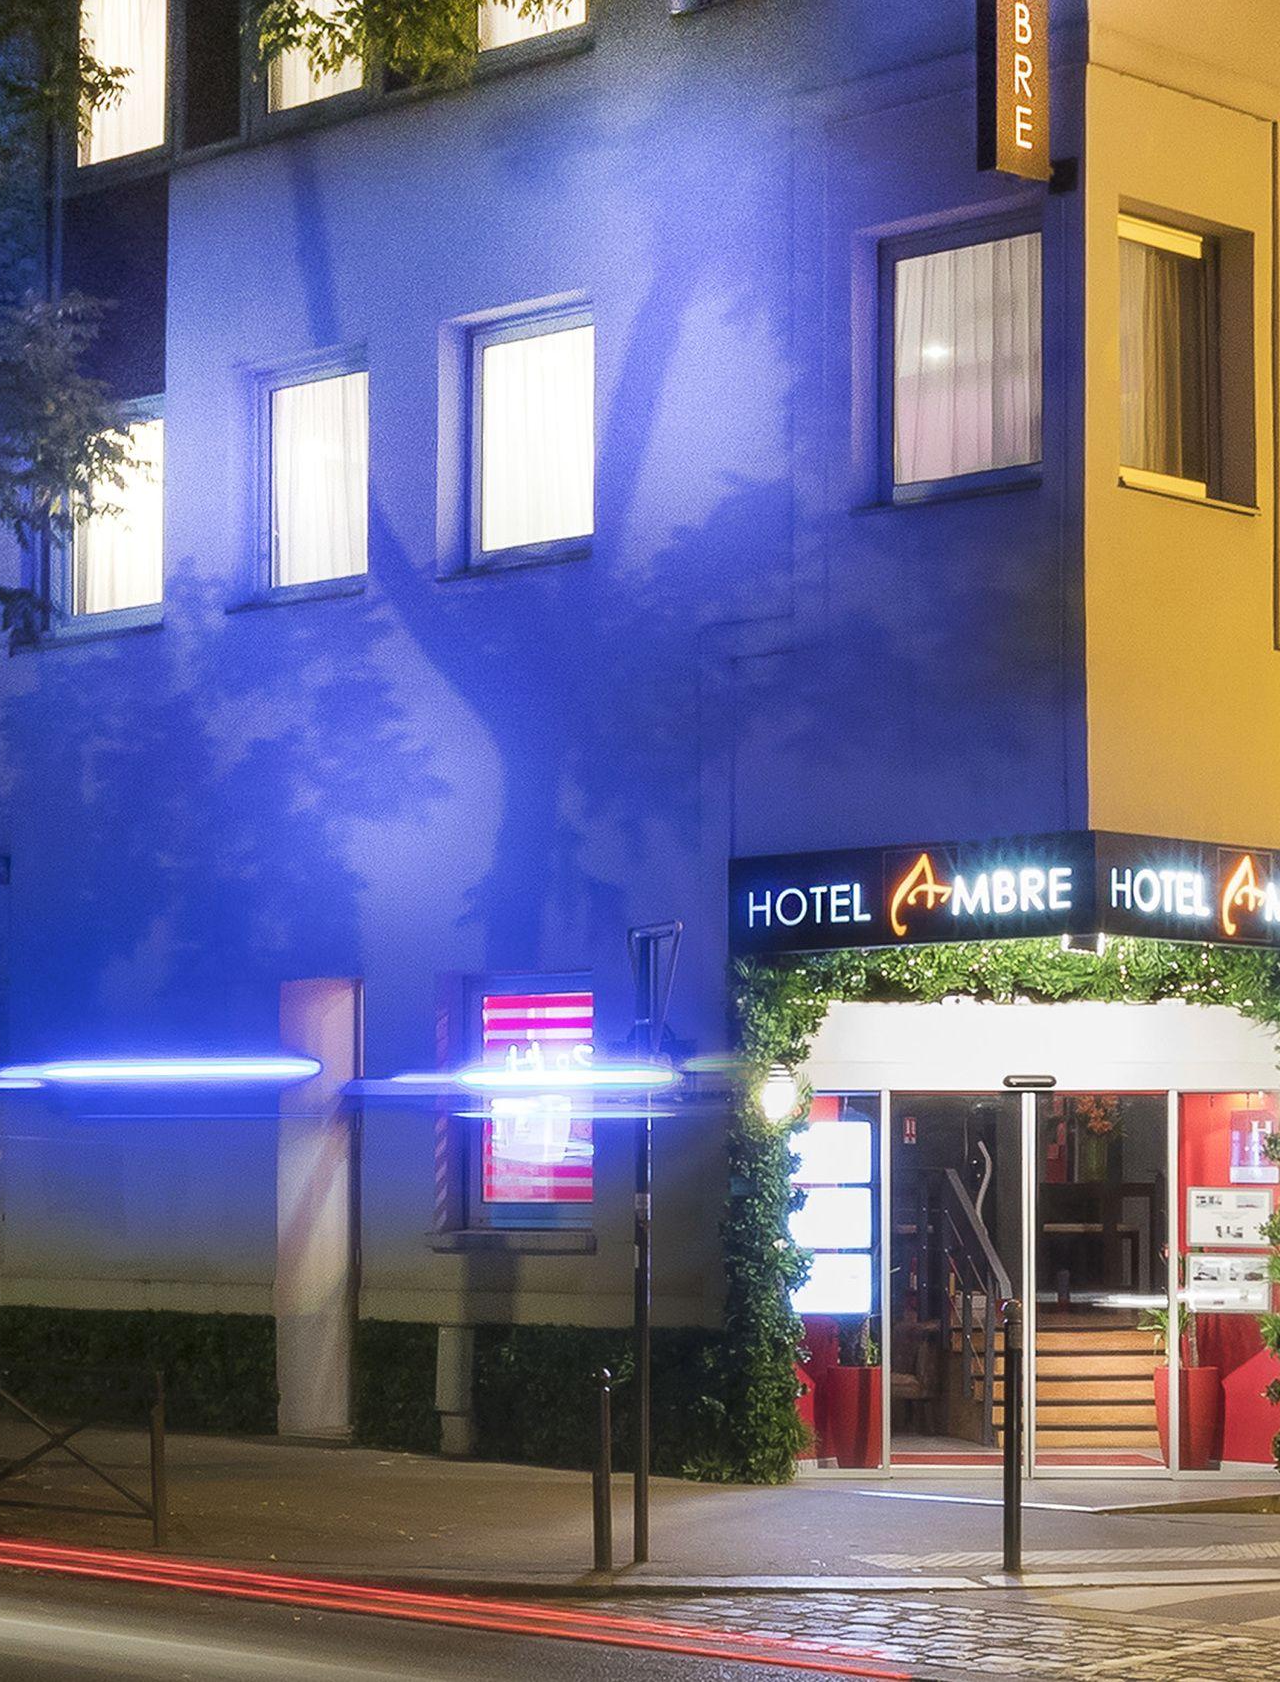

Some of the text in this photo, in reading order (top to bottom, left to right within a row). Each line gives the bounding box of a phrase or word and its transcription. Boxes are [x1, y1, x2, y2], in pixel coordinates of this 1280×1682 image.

[747, 852, 1073, 937] HOTEL AMBRE
[1110, 866, 1211, 918] HOTEL
